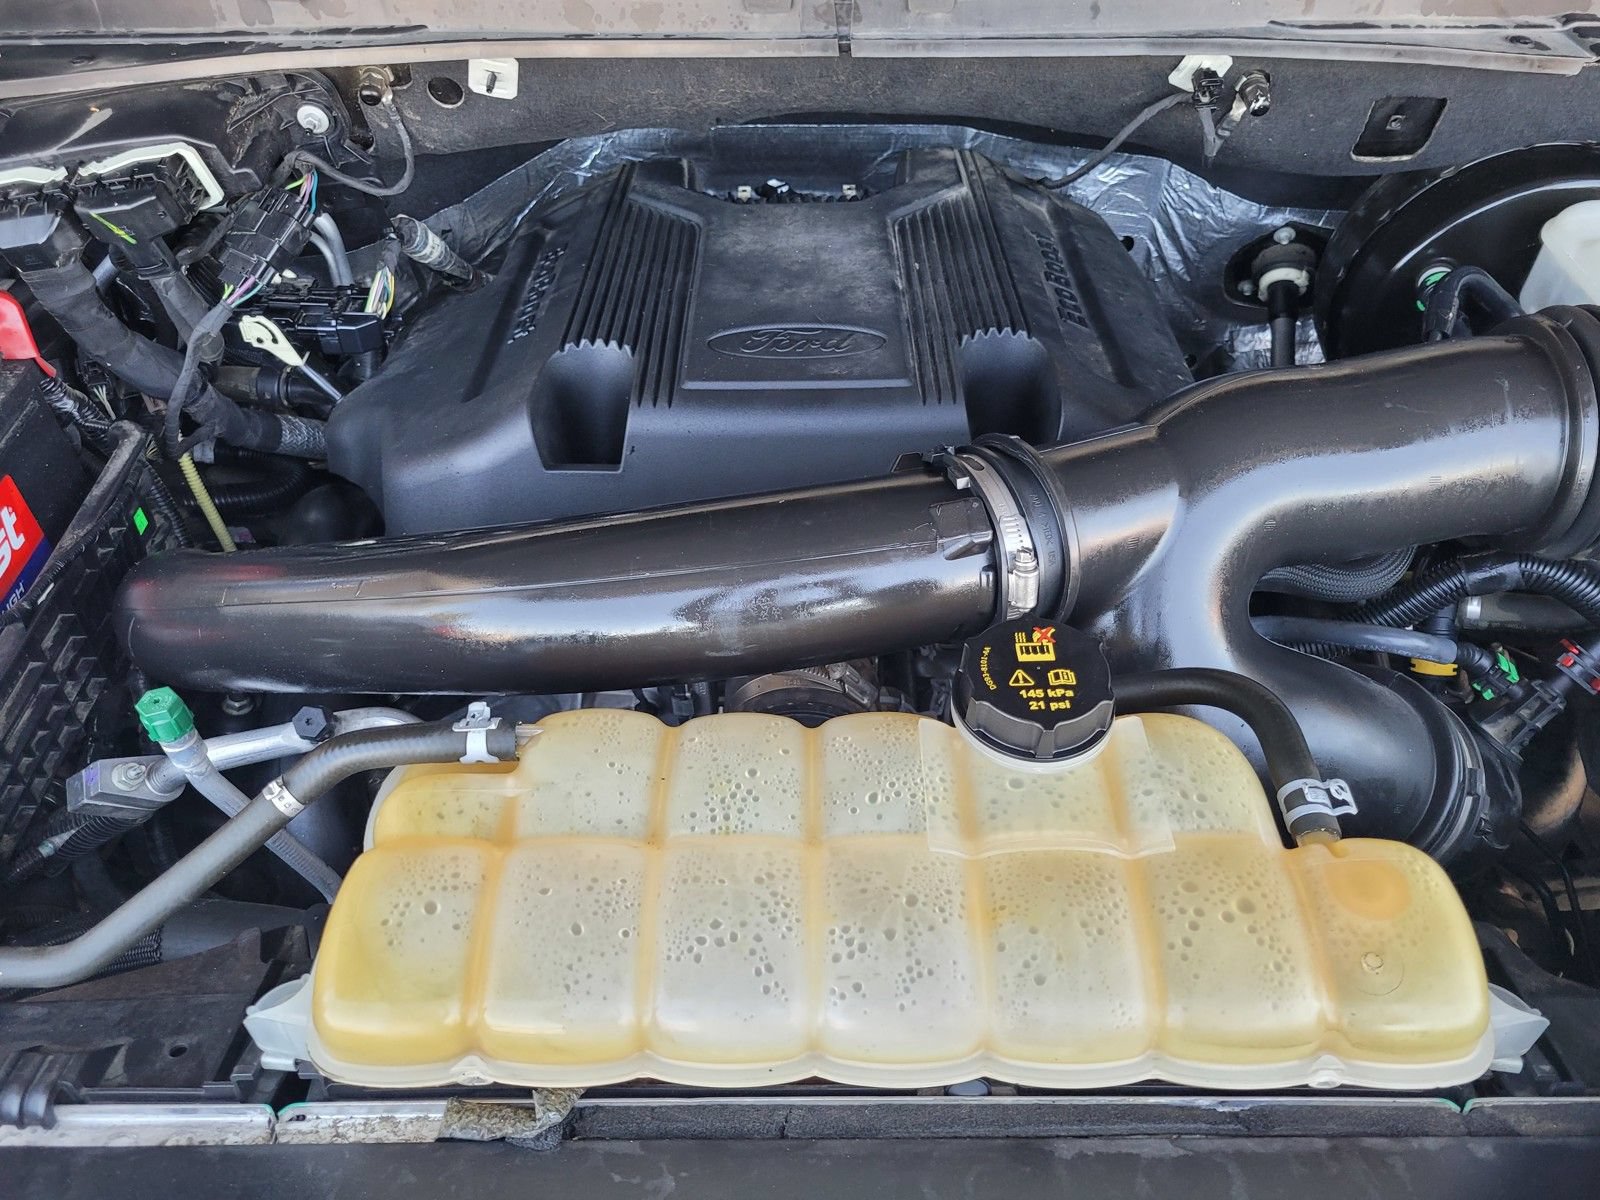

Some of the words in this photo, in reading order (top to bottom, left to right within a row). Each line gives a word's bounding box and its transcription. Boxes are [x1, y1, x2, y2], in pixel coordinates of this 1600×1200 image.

[739, 329, 857, 353] Ford
[1019, 688, 1044, 698] 145
[1047, 688, 1074, 698] kPa
[1028, 701, 1046, 710] 21
[1049, 700, 1071, 711] psi
